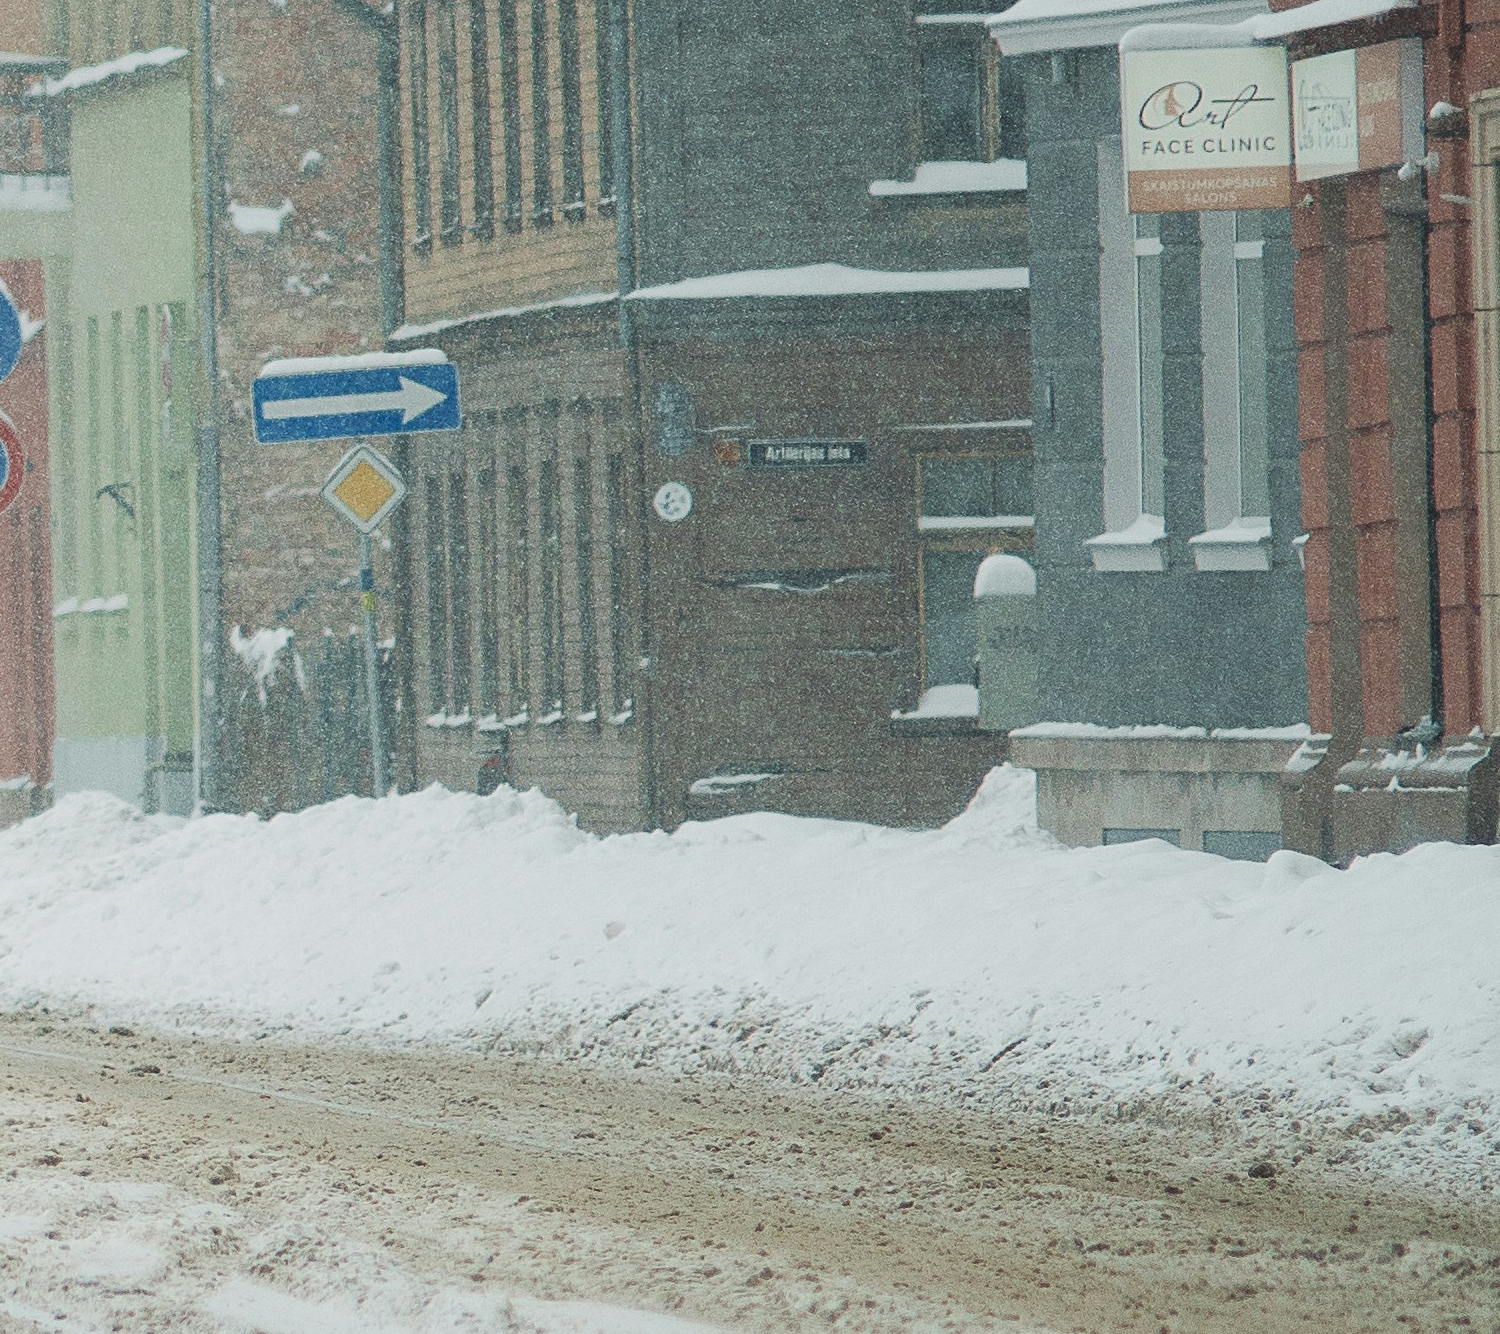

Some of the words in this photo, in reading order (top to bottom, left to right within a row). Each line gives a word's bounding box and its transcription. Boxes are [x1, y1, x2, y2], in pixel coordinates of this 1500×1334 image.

[1141, 138, 1194, 156] FACE
[1202, 136, 1276, 153] CLINIC
[1185, 191, 1238, 205] SALONS
